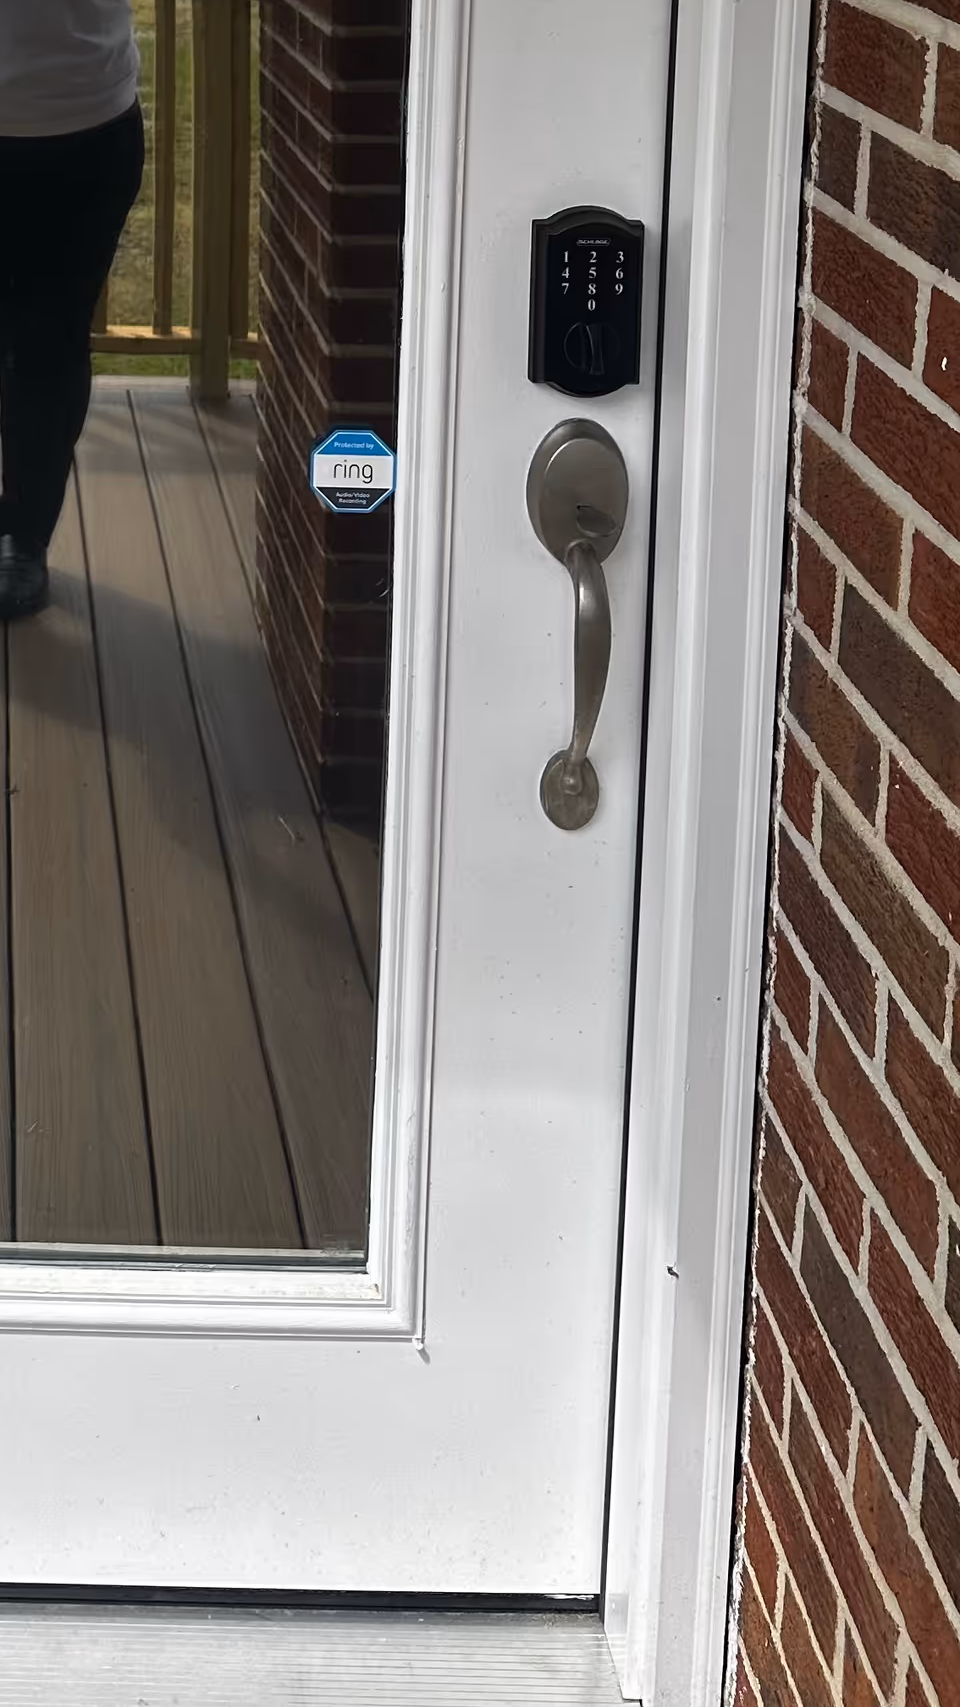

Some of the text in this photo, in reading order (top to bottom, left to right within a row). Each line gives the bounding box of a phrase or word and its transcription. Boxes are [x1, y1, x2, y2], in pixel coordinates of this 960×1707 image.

[563, 251, 624, 263] 1 2 3
[562, 267, 624, 279] 4 5 6
[562, 283, 623, 295] 7 8 9
[588, 299, 596, 311] 0
[333, 459, 373, 484] ring
